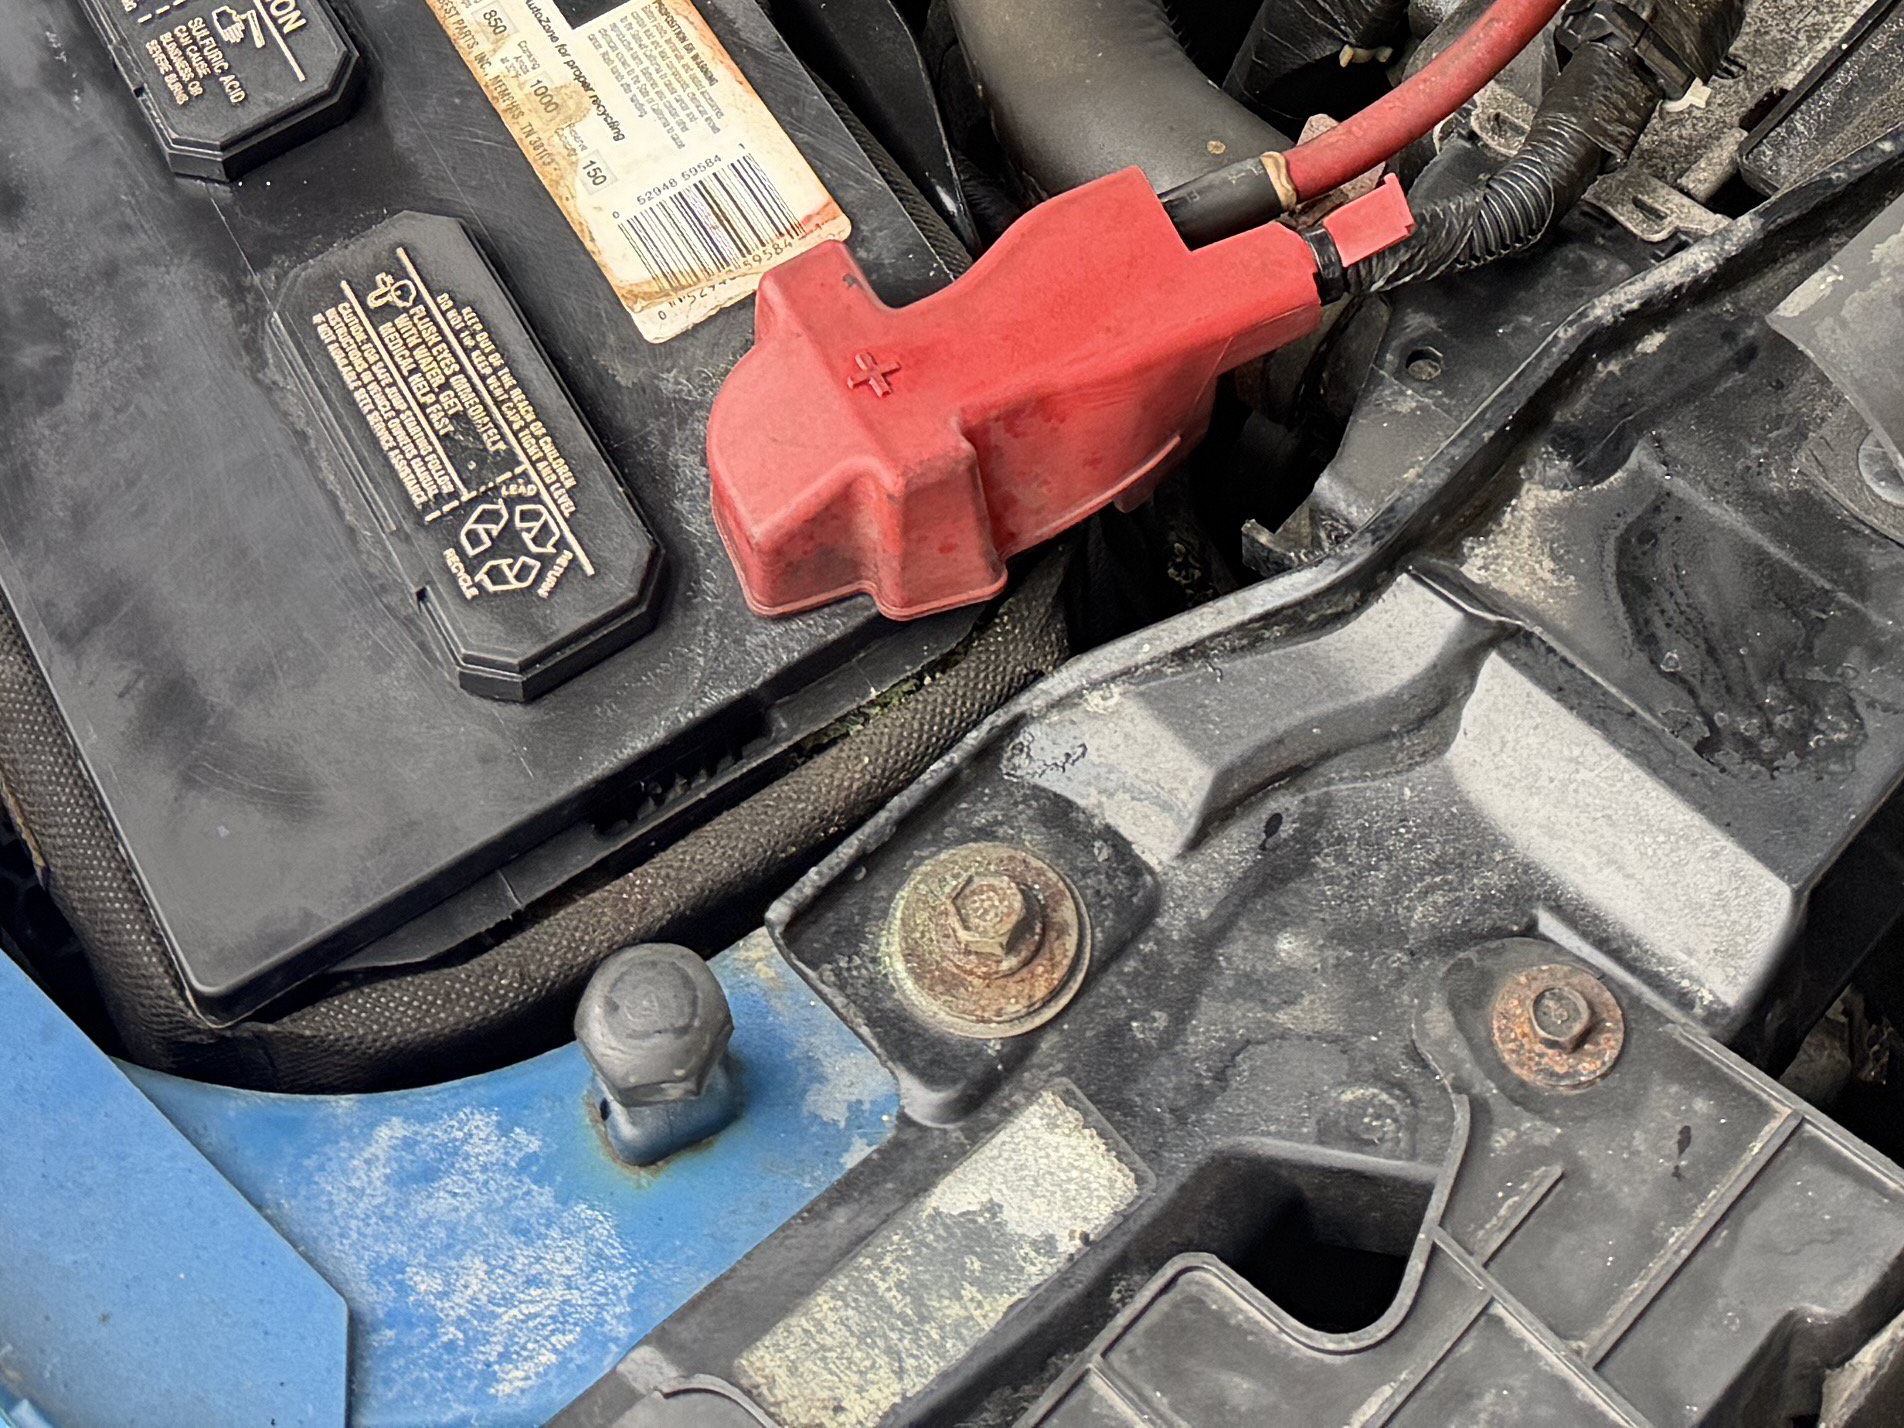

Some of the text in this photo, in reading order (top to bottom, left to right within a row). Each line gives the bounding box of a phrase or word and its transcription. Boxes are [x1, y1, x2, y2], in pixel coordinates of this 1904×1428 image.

[481, 6, 508, 37] 850
[171, 23, 212, 80] CAN CAUSE
[185, 14, 247, 105] SULFURIC ACID
[554, 40, 573, 60] for
[527, 76, 560, 115] 1000
[562, 56, 596, 98] proper
[518, 121, 536, 138] TN
[586, 90, 627, 144] recycling
[580, 157, 608, 188] 150
[611, 209, 621, 220] 0
[680, 152, 723, 181] 59584
[742, 240, 794, 272] 59584
[358, 340, 381, 365] FOR
[474, 329, 496, 354] OUT
[486, 350, 505, 369] OF
[369, 359, 394, 387] SAFE
[376, 320, 455, 438] MEDICAL HELP FAST
[392, 311, 463, 417] WITH WATER. GET
[407, 302, 507, 457] FLUSH EYES IMMEDIATELY
[495, 365, 517, 390] THE
[364, 379, 397, 421] VEHICLE
[434, 291, 454, 311] DO
[444, 307, 466, 331] NOT
[468, 347, 493, 378] KEEP
[484, 373, 509, 403] VENT
[500, 400, 525, 431] CAPS
[516, 427, 544, 462] TIGHT
[534, 457, 558, 485] AND
[508, 385, 538, 424] REACH
[527, 418, 547, 439] OF
[537, 434, 577, 490] CHILDREN
[501, 482, 538, 498] LEAD
[442, 547, 481, 601] RECYCLE
[537, 549, 574, 599] RETURN
